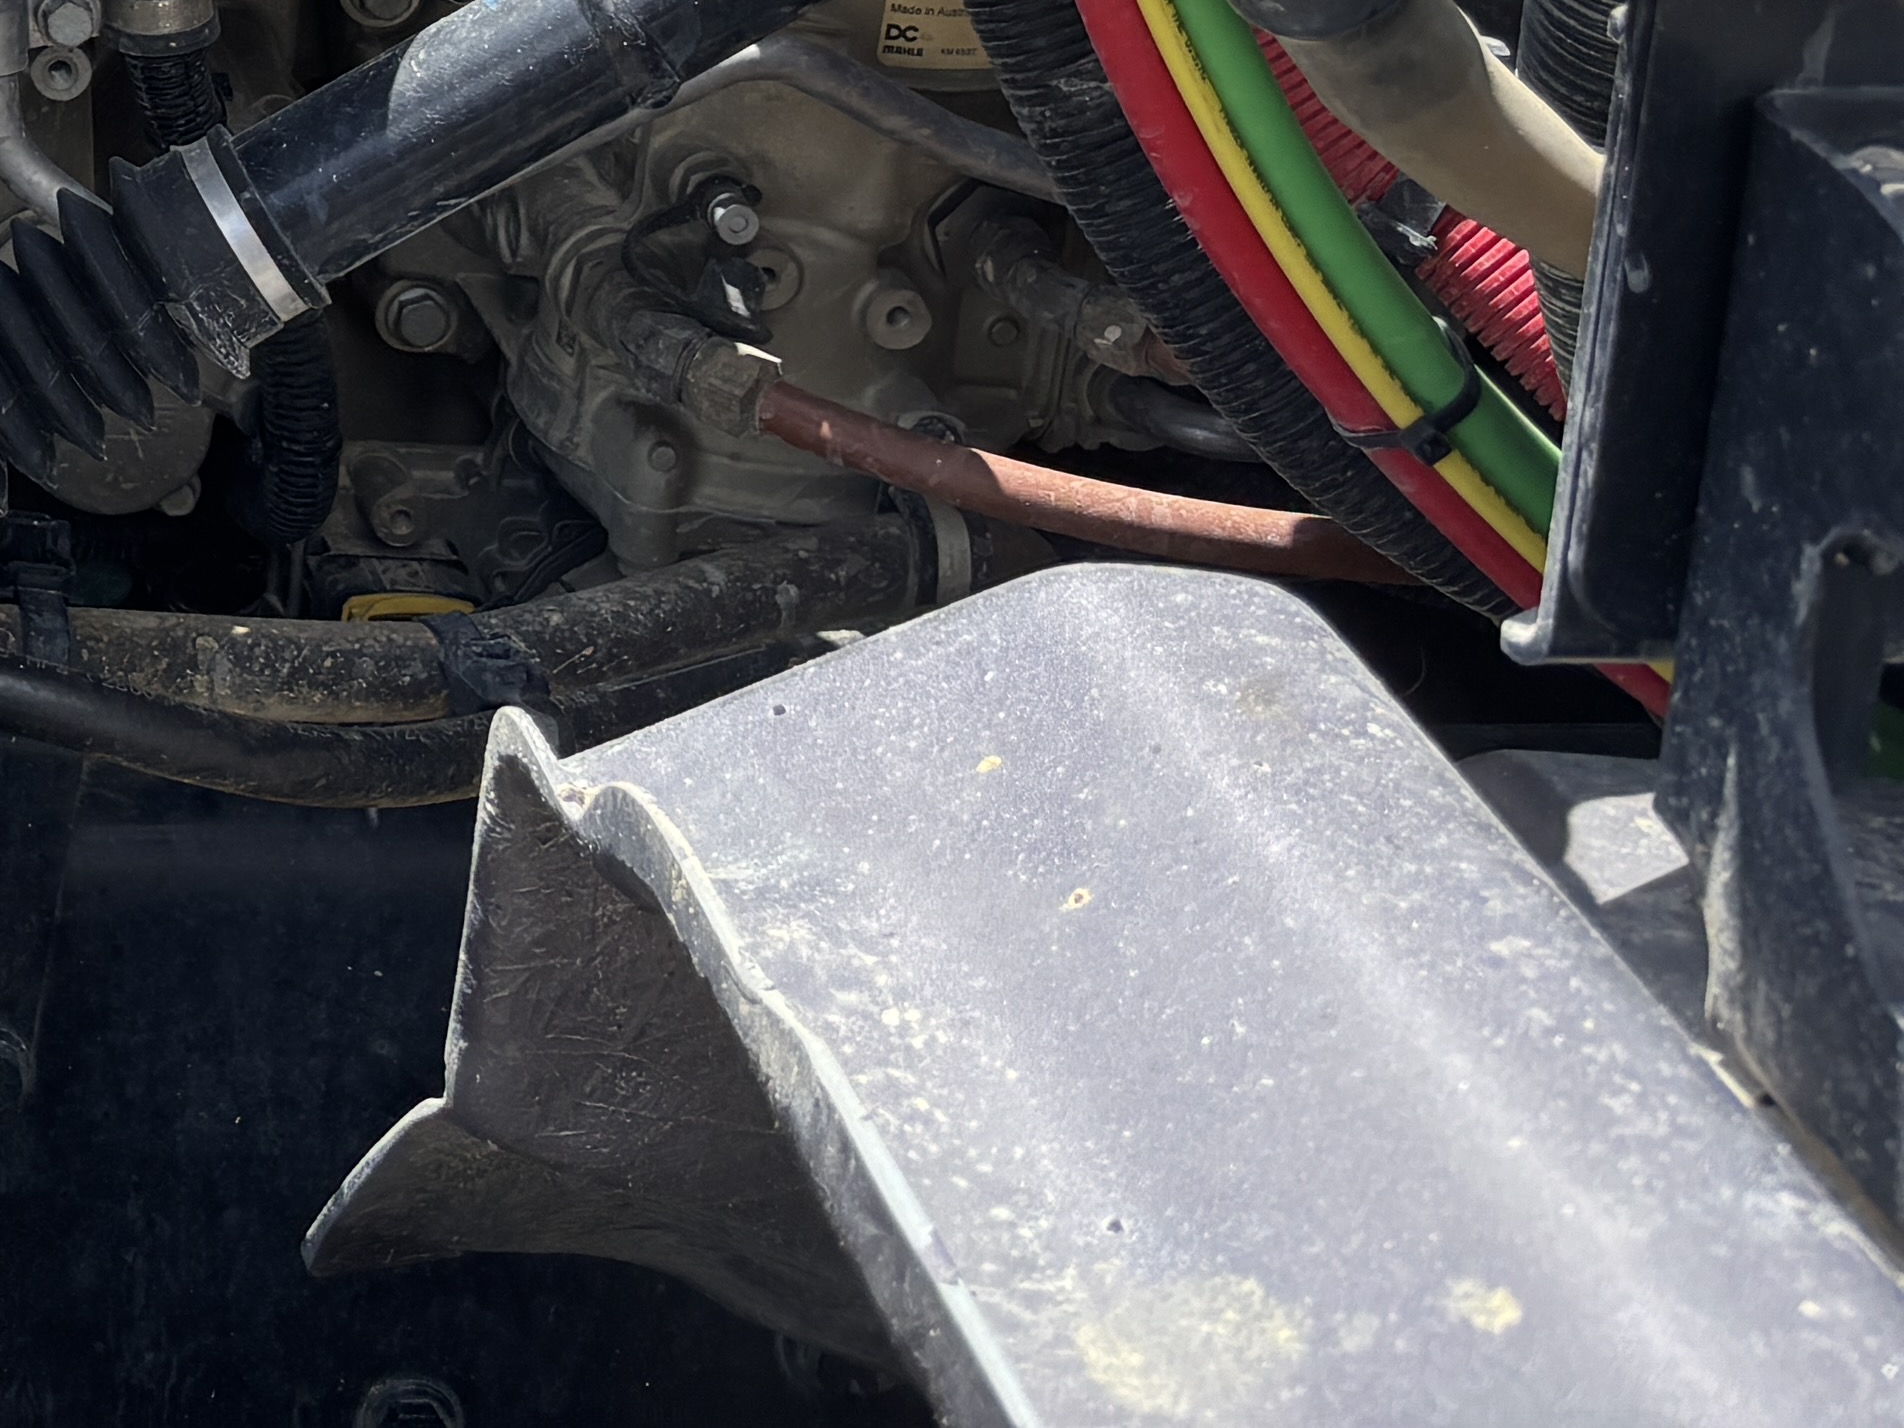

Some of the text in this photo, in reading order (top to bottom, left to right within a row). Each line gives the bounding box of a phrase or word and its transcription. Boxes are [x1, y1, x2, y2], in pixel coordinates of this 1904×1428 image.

[890, 3, 922, 15] Made
[924, 6, 935, 15] in
[884, 23, 919, 42] DC
[882, 45, 924, 56] MAHLE
